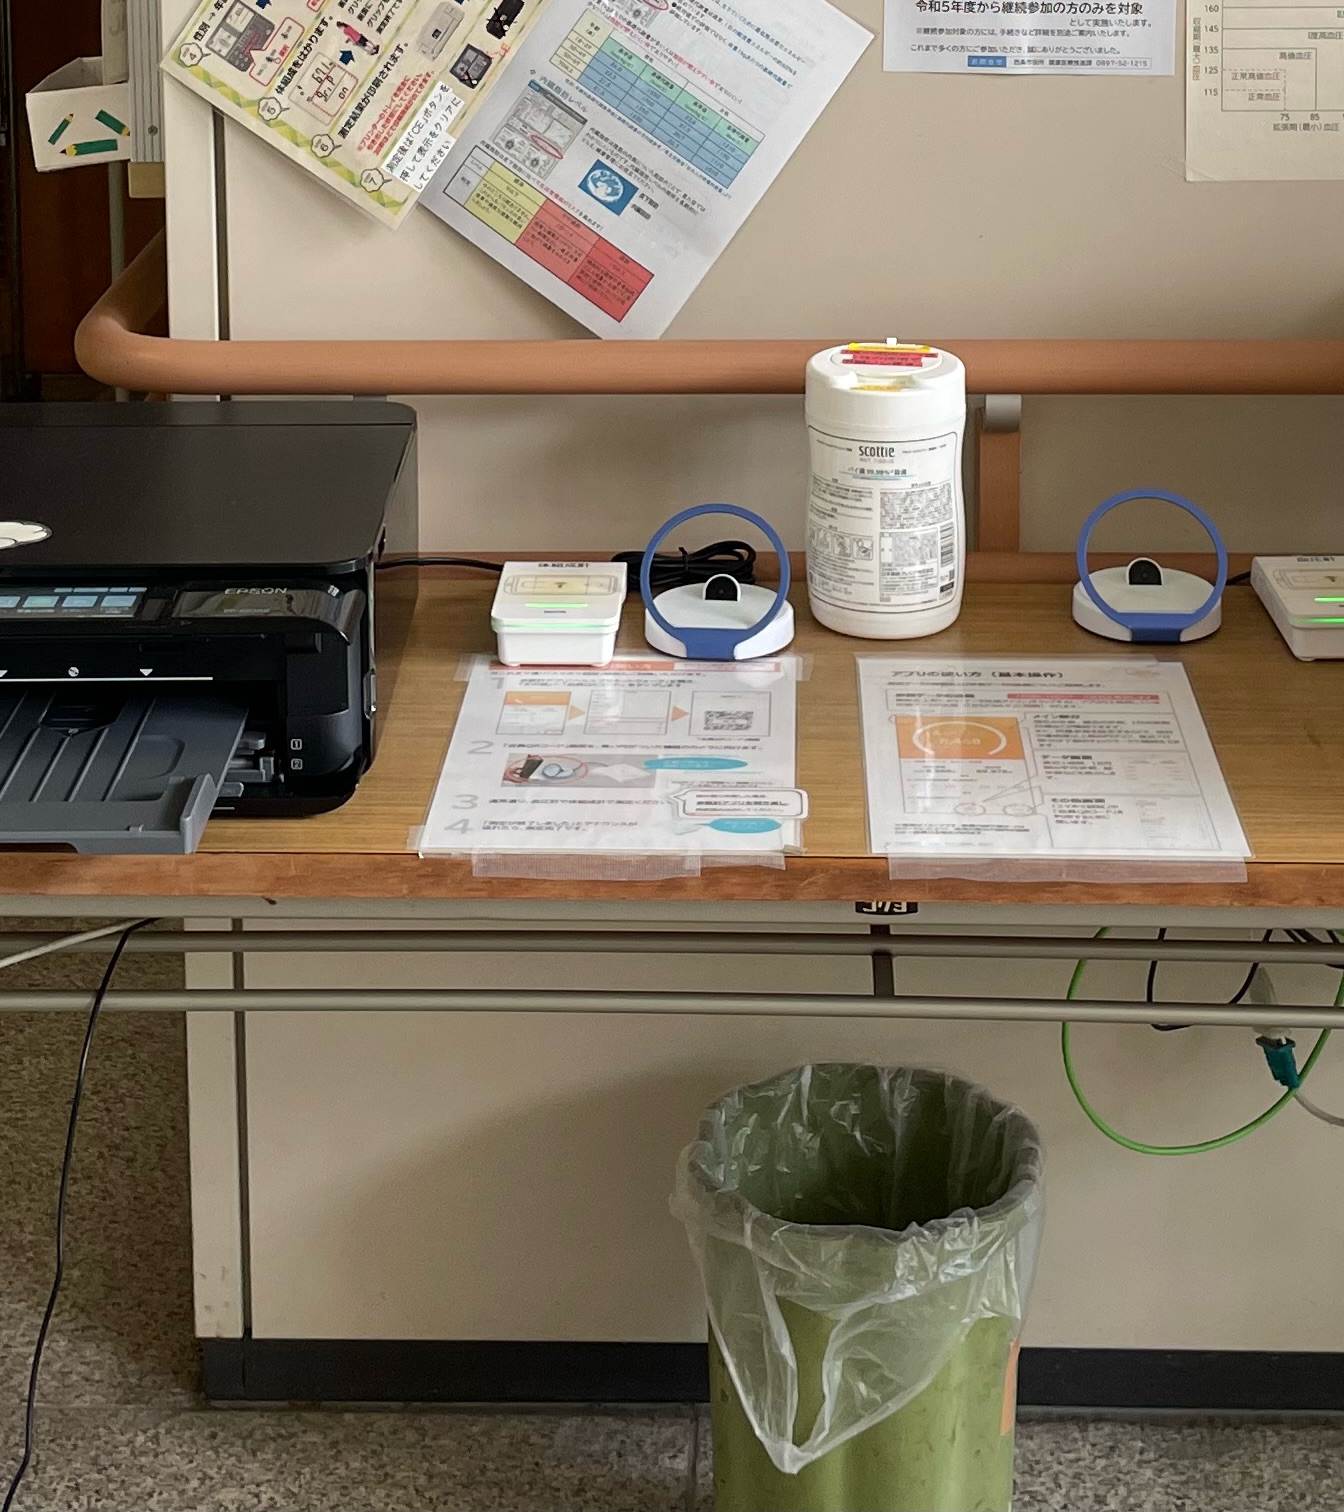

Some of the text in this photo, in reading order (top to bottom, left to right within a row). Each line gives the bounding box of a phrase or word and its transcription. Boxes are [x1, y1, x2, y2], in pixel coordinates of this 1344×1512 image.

[915, 1, 1143, 15] 令和5年度から継続参加の方のみを対象
[1205, 4, 1219, 13] 160
[1205, 25, 1219, 33] 145
[1280, 113, 1290, 121] 75
[1310, 113, 1320, 121] 85
[858, 446, 895, 458] scottie
